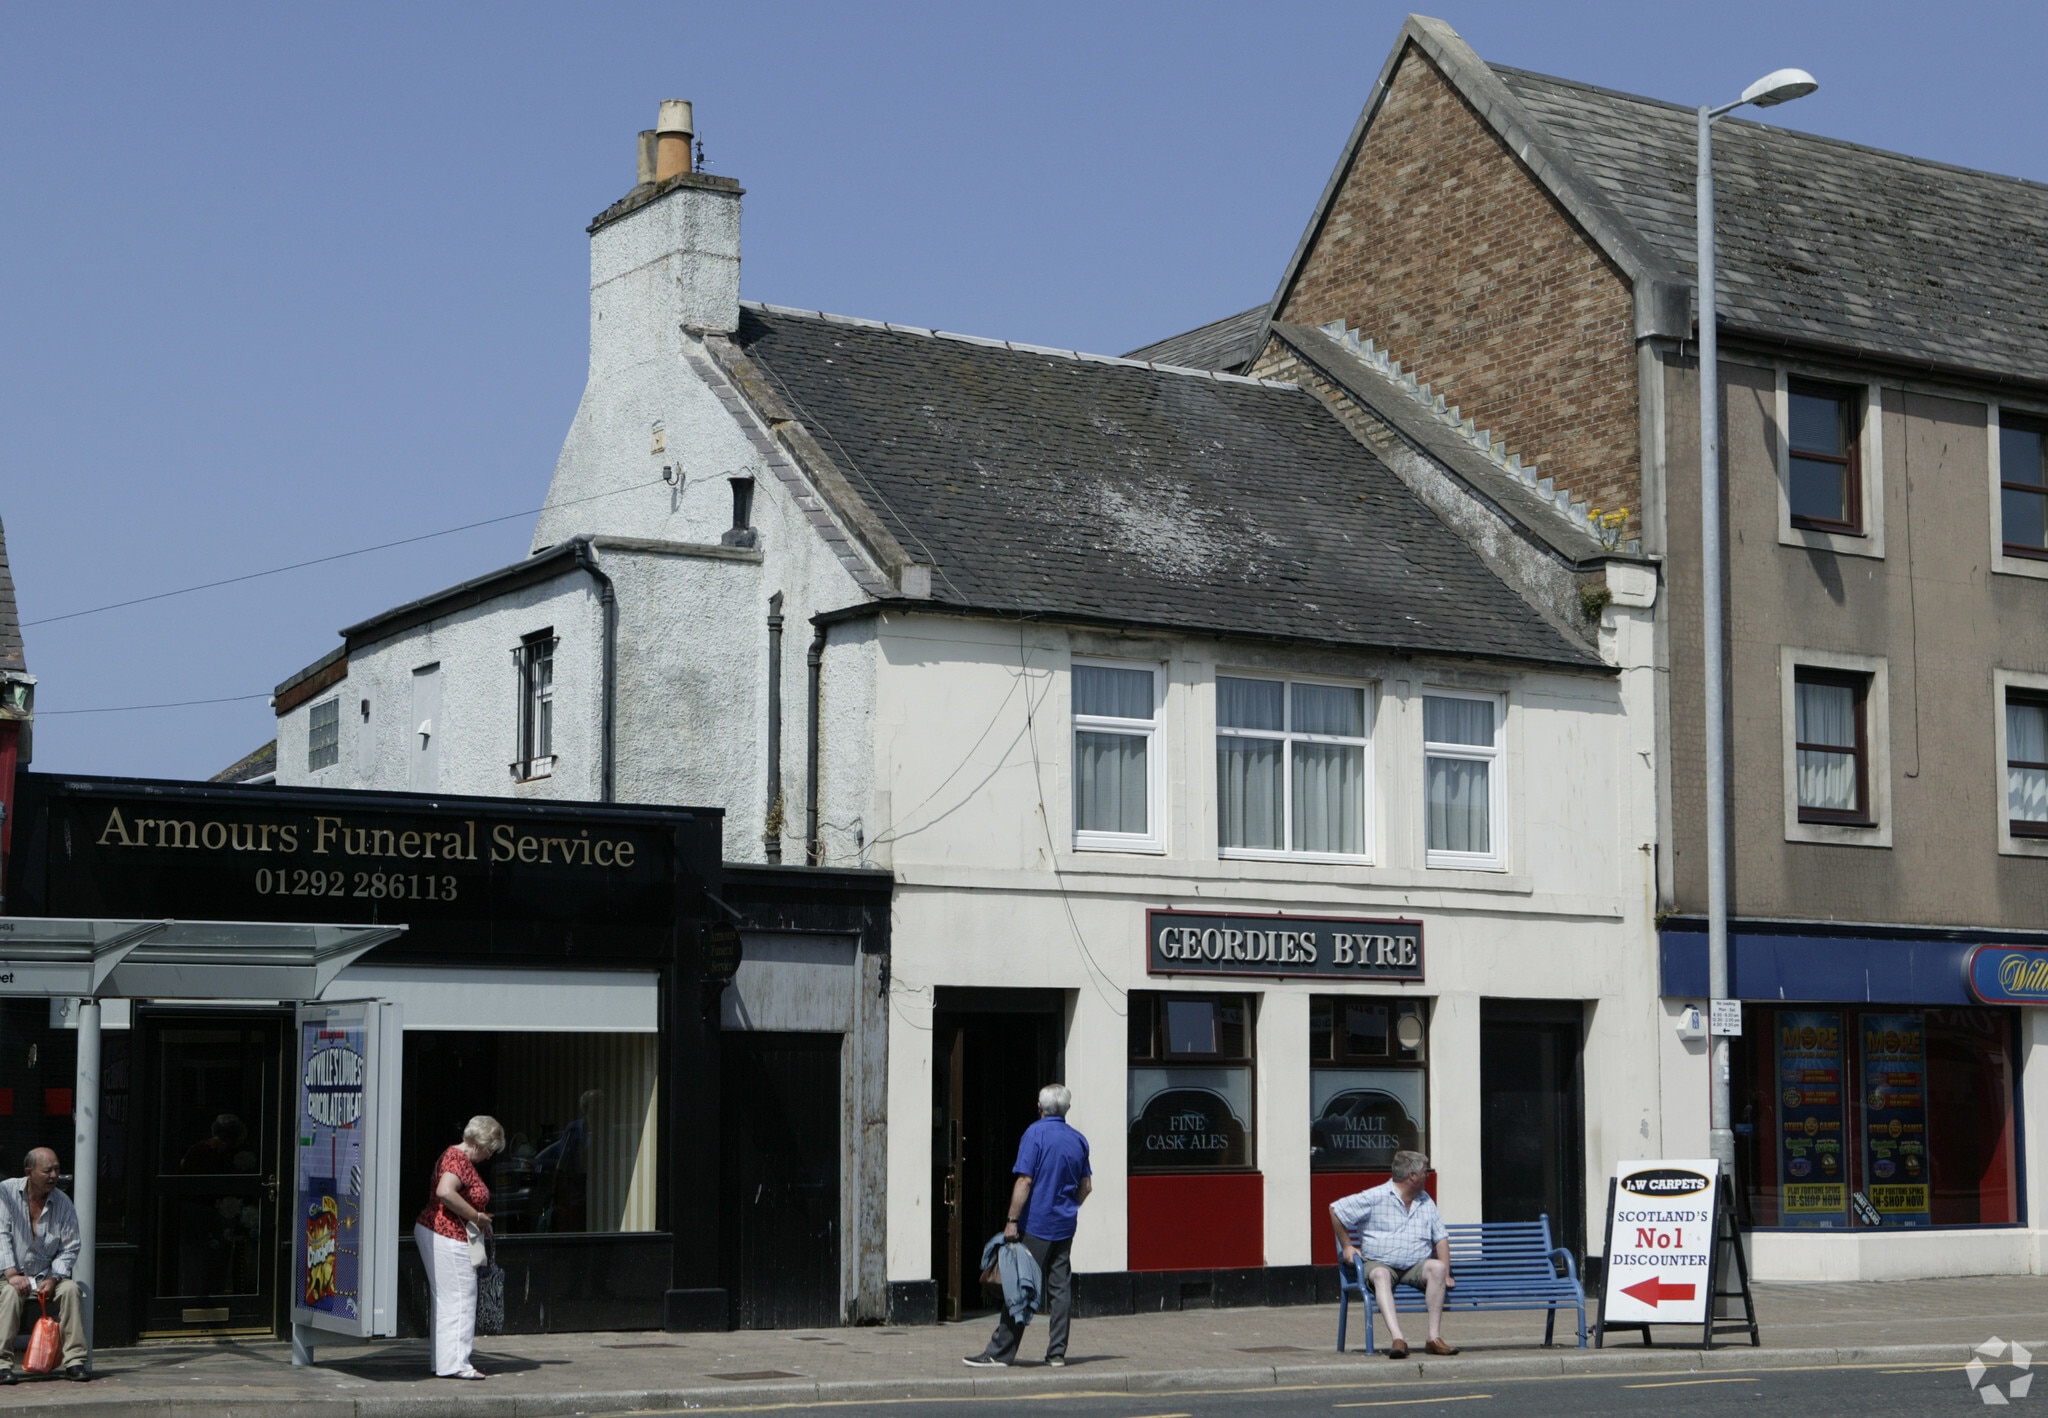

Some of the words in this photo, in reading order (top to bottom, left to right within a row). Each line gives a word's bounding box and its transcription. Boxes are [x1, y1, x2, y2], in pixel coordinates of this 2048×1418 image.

[96, 807, 298, 852] Armours
[312, 816, 478, 861] Funeral
[491, 824, 635, 867] Service
[255, 868, 345, 897] 01292
[352, 872, 457, 901] 286113
[1158, 926, 1318, 964] GEORDIES
[1332, 933, 1417, 967] BYRE
[1783, 1026, 1838, 1049] MORE
[1867, 1030, 1920, 1053] MORE
[308, 1092, 341, 1126] CHOCOLATE
[1170, 1116, 1206, 1131] FINE
[1344, 1116, 1386, 1131] MALT
[1146, 1134, 1185, 1150] CASK
[1189, 1134, 1229, 1150] ALES
[1331, 1134, 1400, 1149] WHISKIES
[1649, 1178, 1706, 1190] CARPETS
[324, 1197, 336, 1212] NEW
[1788, 1195, 1821, 1207] IN-SHOP
[1822, 1194, 1841, 1206] NOW
[1906, 1195, 1924, 1207] NOW
[1618, 1211, 1708, 1223] SCOTLAND'S
[1865, 1206, 1880, 1226] CARD
[1613, 1254, 1708, 1266] DISCOUNTER
